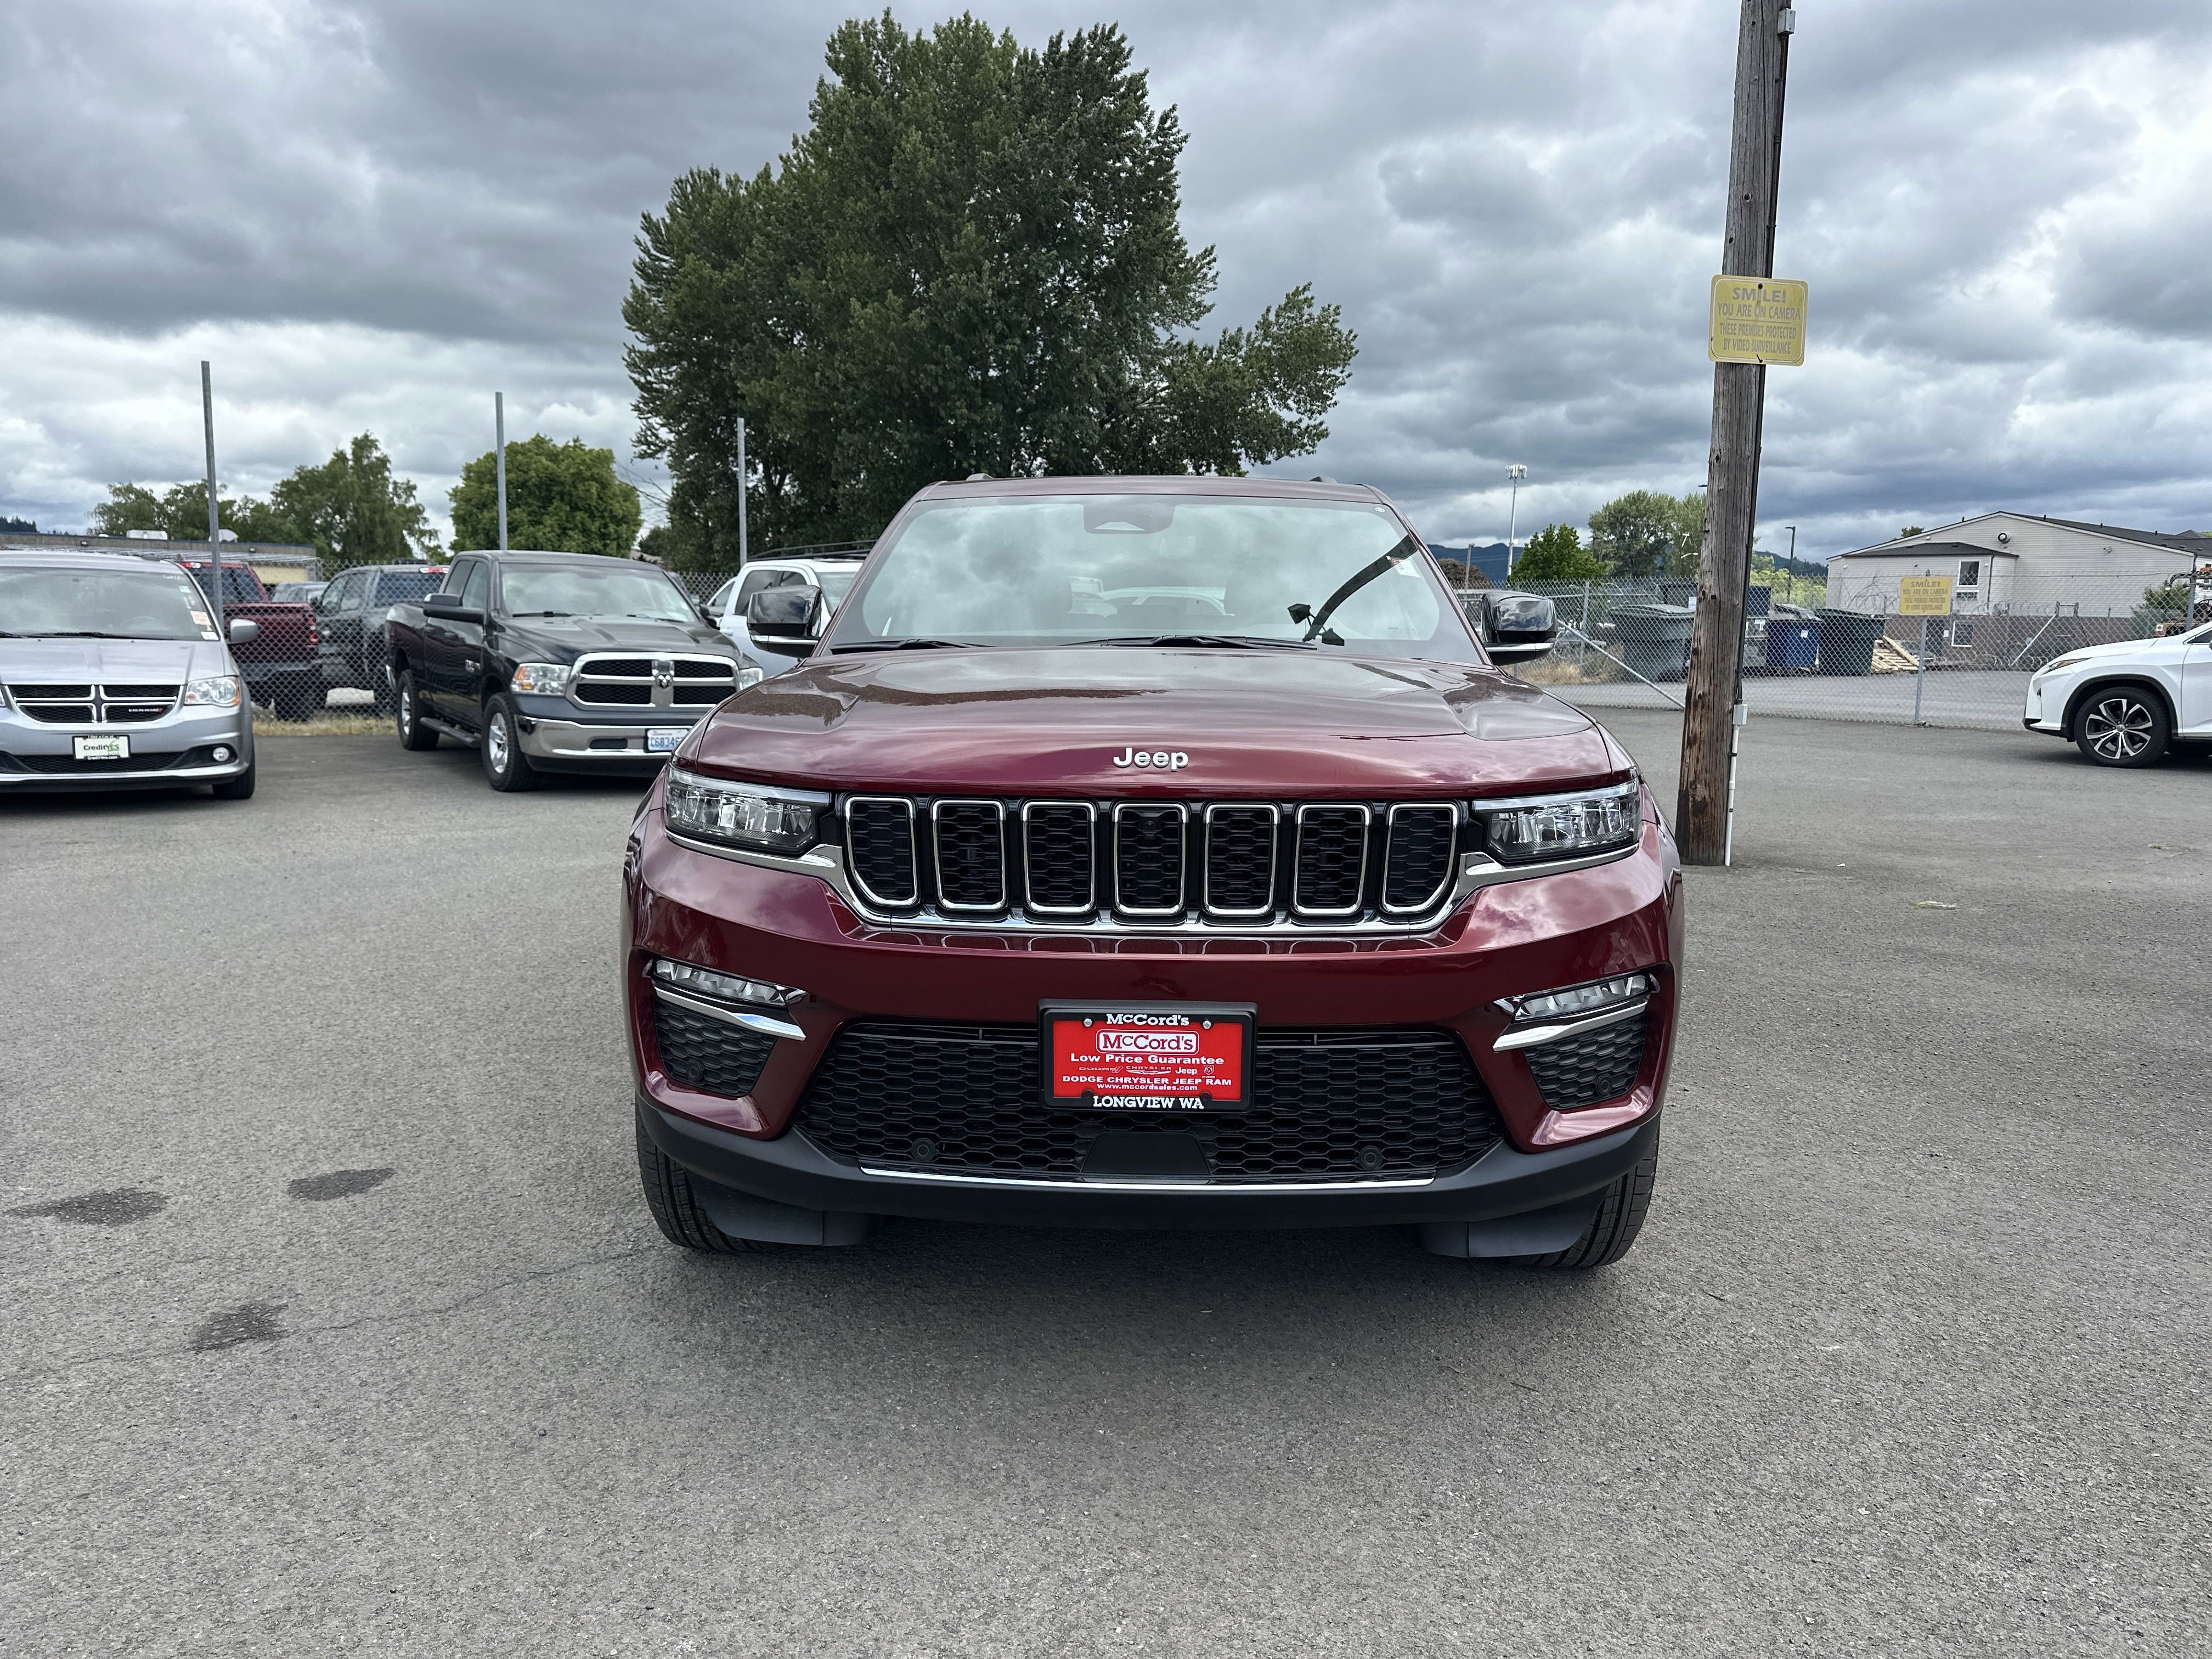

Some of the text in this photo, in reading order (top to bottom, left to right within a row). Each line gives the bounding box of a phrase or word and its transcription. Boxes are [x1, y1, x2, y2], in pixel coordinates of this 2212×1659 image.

[1733, 287, 1787, 303] SMILE!
[1718, 302, 1801, 321] YOU ARE ON CAMERA
[1719, 323, 1796, 339] THESE PREMISES PROTECTED
[1723, 338, 1791, 354] BY VIDEO SURVEILLANCE
[1113, 747, 1189, 772] Jeep
[1106, 1013, 1189, 1026] McCord's
[1102, 1034, 1193, 1050] McCord's
[1070, 1053, 1224, 1065] Low Price Guarantee
[1175, 1066, 1198, 1075] Jeep
[1107, 1076, 1169, 1085] CHRYSLER
[1093, 1096, 1204, 1109] LONGVIEW WA
